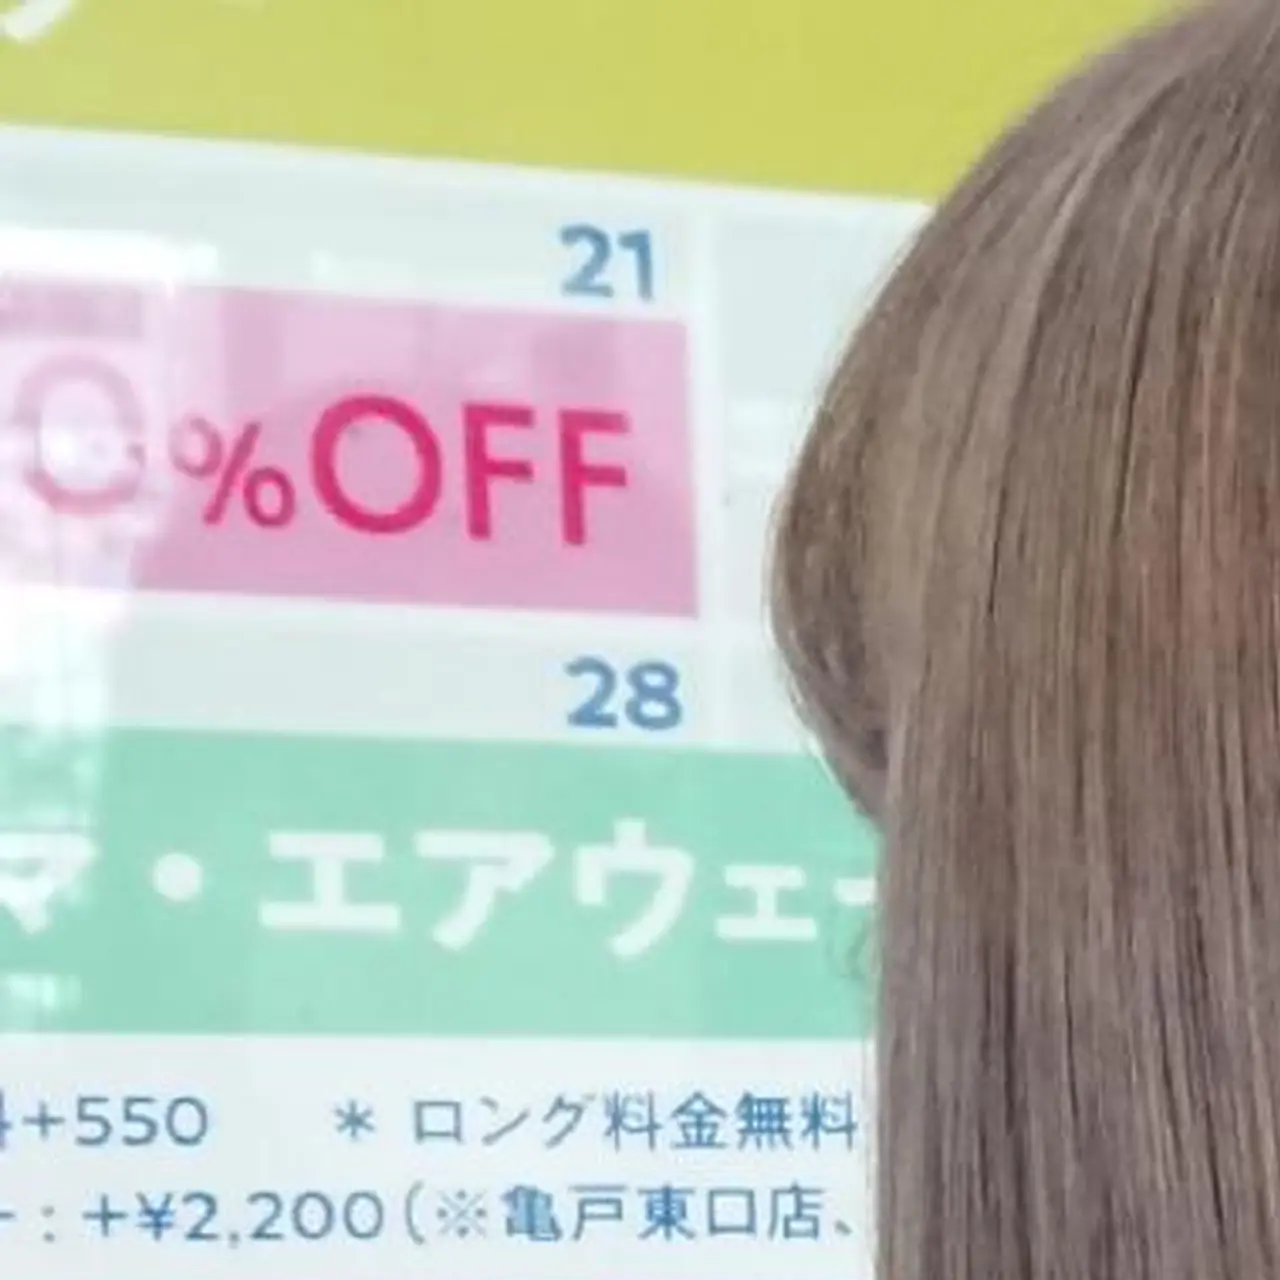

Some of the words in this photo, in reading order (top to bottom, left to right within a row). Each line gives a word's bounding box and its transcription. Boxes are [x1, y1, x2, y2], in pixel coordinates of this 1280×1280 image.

[559, 224, 654, 301] 21
[564, 656, 682, 731] 28
[0, 1087, 208, 1146] +550
